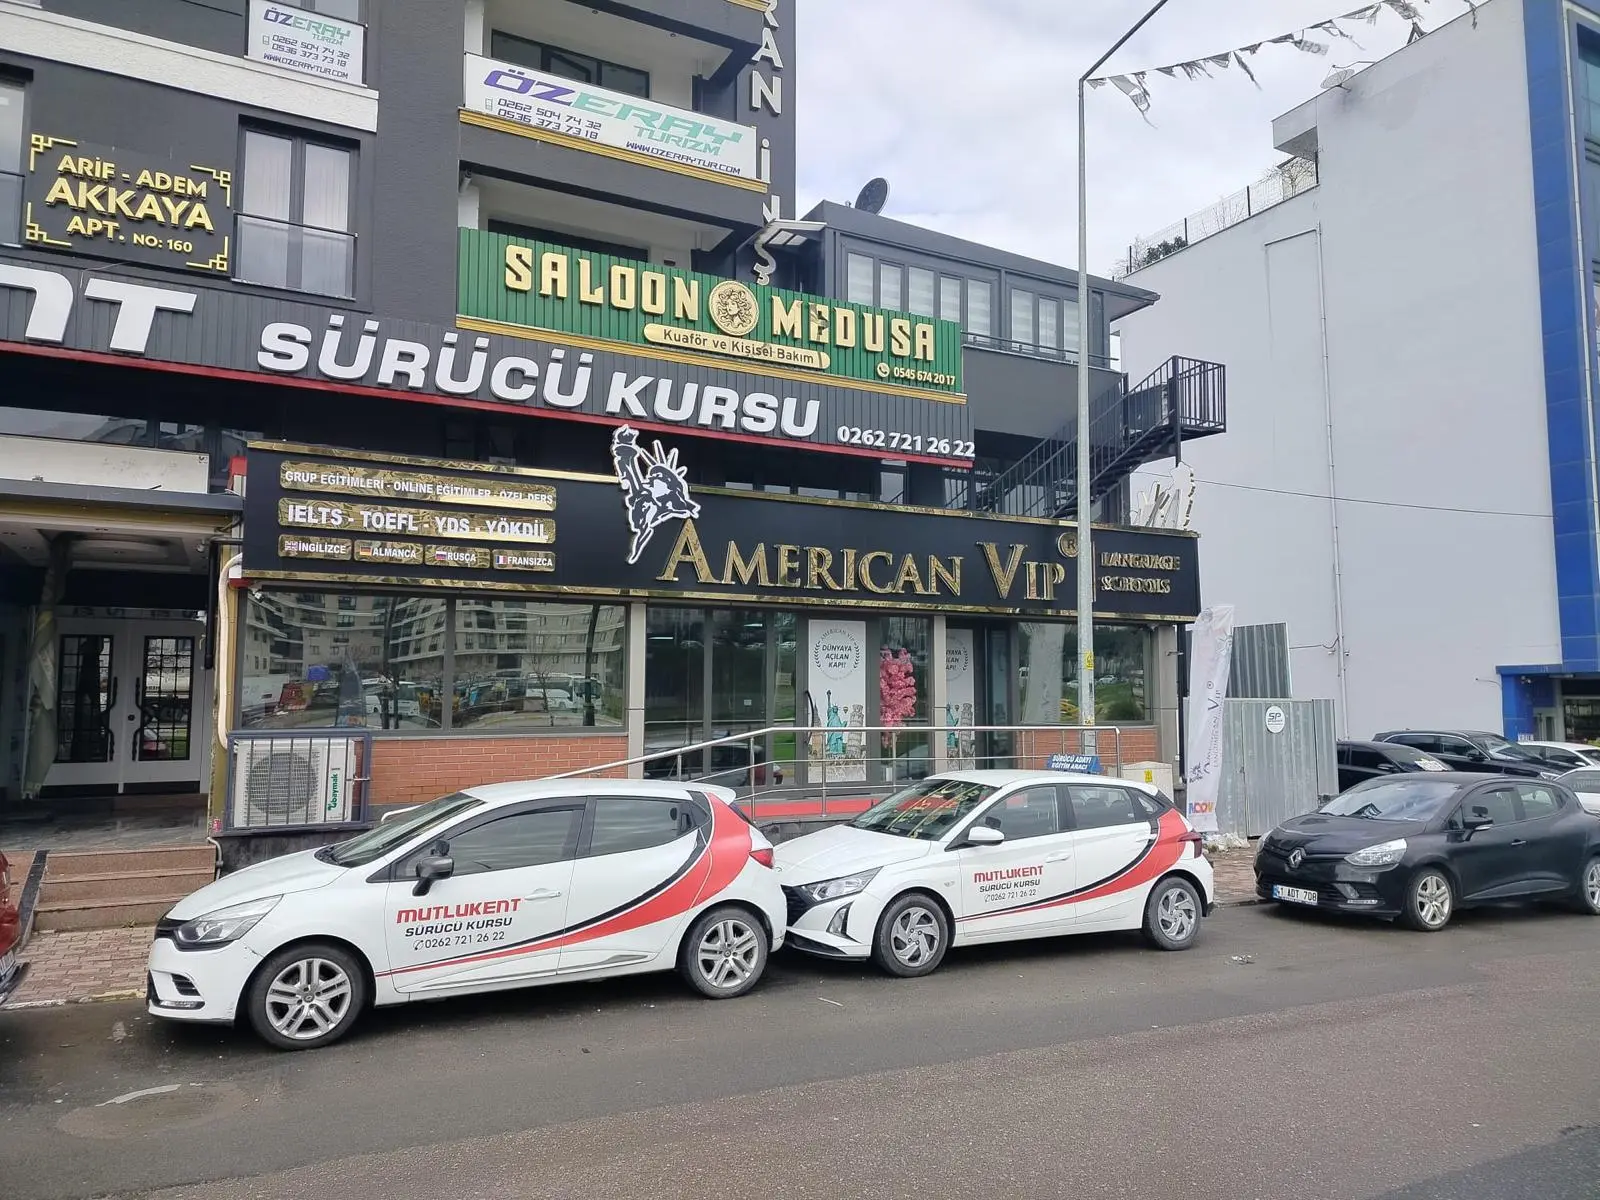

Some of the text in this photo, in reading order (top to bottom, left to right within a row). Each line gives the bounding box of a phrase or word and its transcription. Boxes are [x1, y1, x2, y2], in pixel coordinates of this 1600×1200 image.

[264, 7, 351, 39] ÖZERAY
[272, 35, 350, 59] 0262 504 74 32
[272, 43, 347, 67] 0536 373 73 18
[483, 69, 743, 146] ÖZERAY
[498, 98, 602, 130] 0262 504 74 32
[498, 108, 599, 140] 0536 373 73 18
[633, 125, 720, 156] TURIZM
[626, 141, 740, 175] WWW.OZERAYTUR.COM
[57, 154, 115, 182] ARİF
[136, 169, 207, 200] ADEM
[45, 177, 214, 234] AKKAYA
[66, 216, 193, 253] APT. NO: 160
[505, 243, 935, 362] SALOON MEDUSA
[664, 328, 814, 364] Kuaför ve Kişisel Bakım
[257, 314, 593, 408] SÜRÜCÜ
[605, 371, 820, 439] KURSU
[893, 367, 956, 385] 0545 674 20 17
[837, 425, 975, 458] 0262 721 26 22
[285, 471, 317, 483] GRUP
[320, 472, 384, 489] EĞİTİMLERİ
[393, 481, 433, 493] ONLINE
[436, 482, 491, 497] EĞİTİMLER
[500, 488, 524, 500] ÖZEL
[527, 493, 553, 504] DERS
[288, 504, 343, 526] IELTS
[360, 510, 418, 531] TOEFL
[434, 516, 470, 533] YDS
[485, 517, 549, 540] YÖKDİL
[298, 540, 347, 554] İNGİLİZCE
[372, 547, 417, 558] ALMANCA
[447, 553, 477, 563] RUSÇA
[656, 518, 965, 597] AMERICAN
[976, 541, 1066, 601] VIP
[1101, 552, 1180, 570] LANGUAGE
[507, 557, 553, 566] FRANSIZCA
[1101, 575, 1171, 593] SCHOOLS
[822, 643, 852, 652] DÜNYAYA
[330, 773, 339, 808] baymak
[974, 865, 1044, 883] MUTLUKENT
[979, 878, 1041, 893] SÜRÜCÜ KURSU
[990, 888, 1037, 901] 0262 721 26 22
[1303, 891, 1317, 901] 708
[396, 898, 521, 924] MUTLUKENT
[405, 917, 513, 937] SÜRÜCÜ KURSU
[425, 931, 505, 949] 0262 721 26 22
